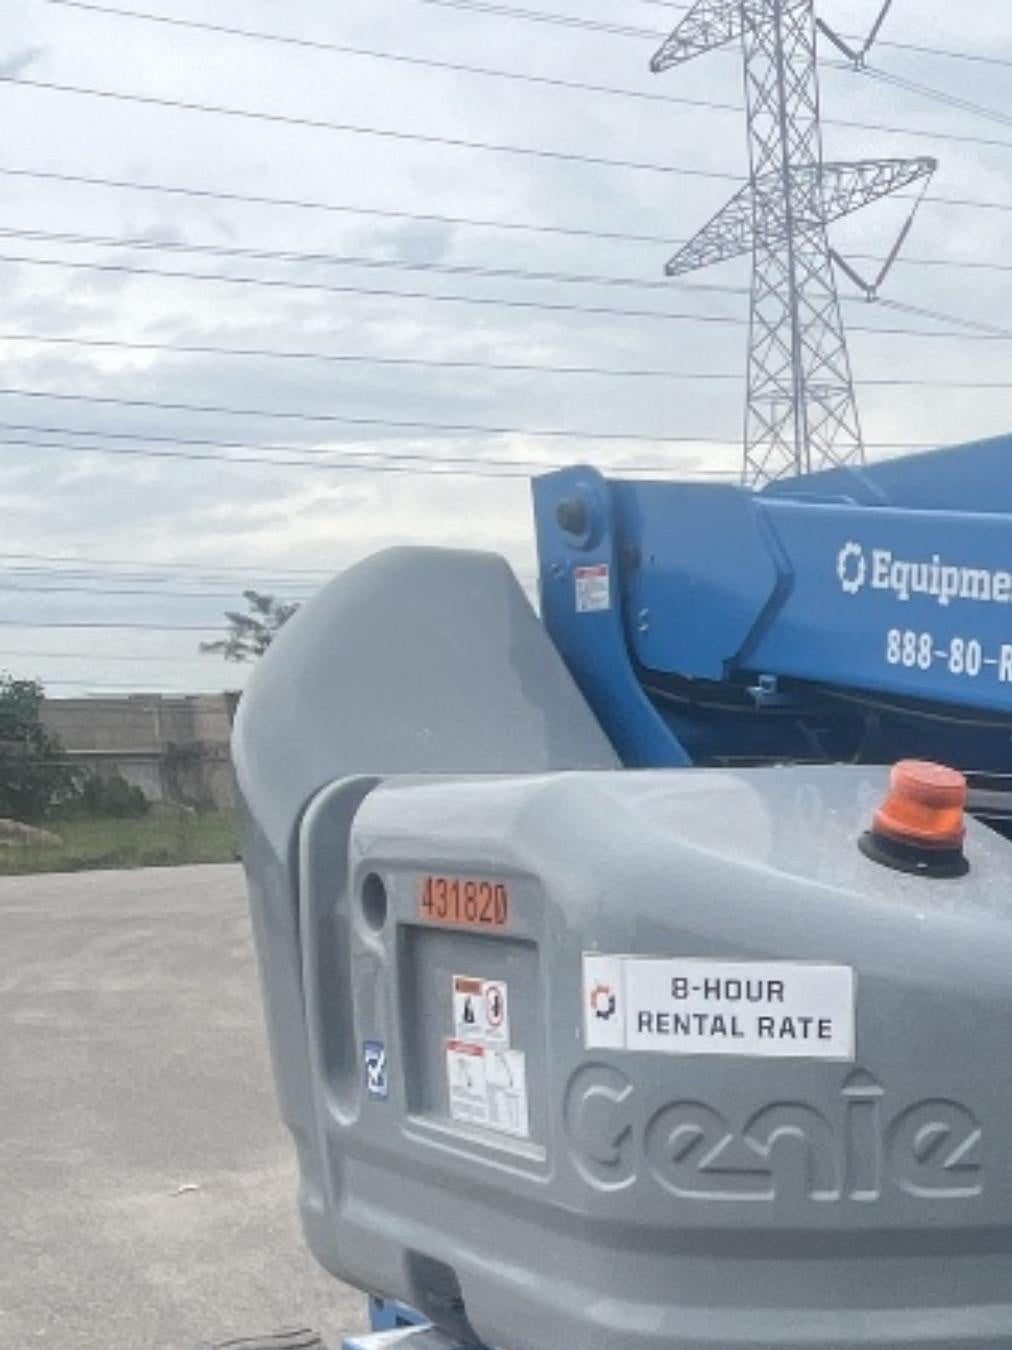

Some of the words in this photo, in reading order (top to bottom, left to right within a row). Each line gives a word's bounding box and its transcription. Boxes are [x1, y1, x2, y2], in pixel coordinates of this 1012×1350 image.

[421, 875, 509, 925] 431820
[670, 976, 785, 1003] 8-HOUR
[637, 1011, 745, 1039] RENTAL
[757, 1015, 833, 1041] RATE
[563, 1061, 982, 1201] Genie
